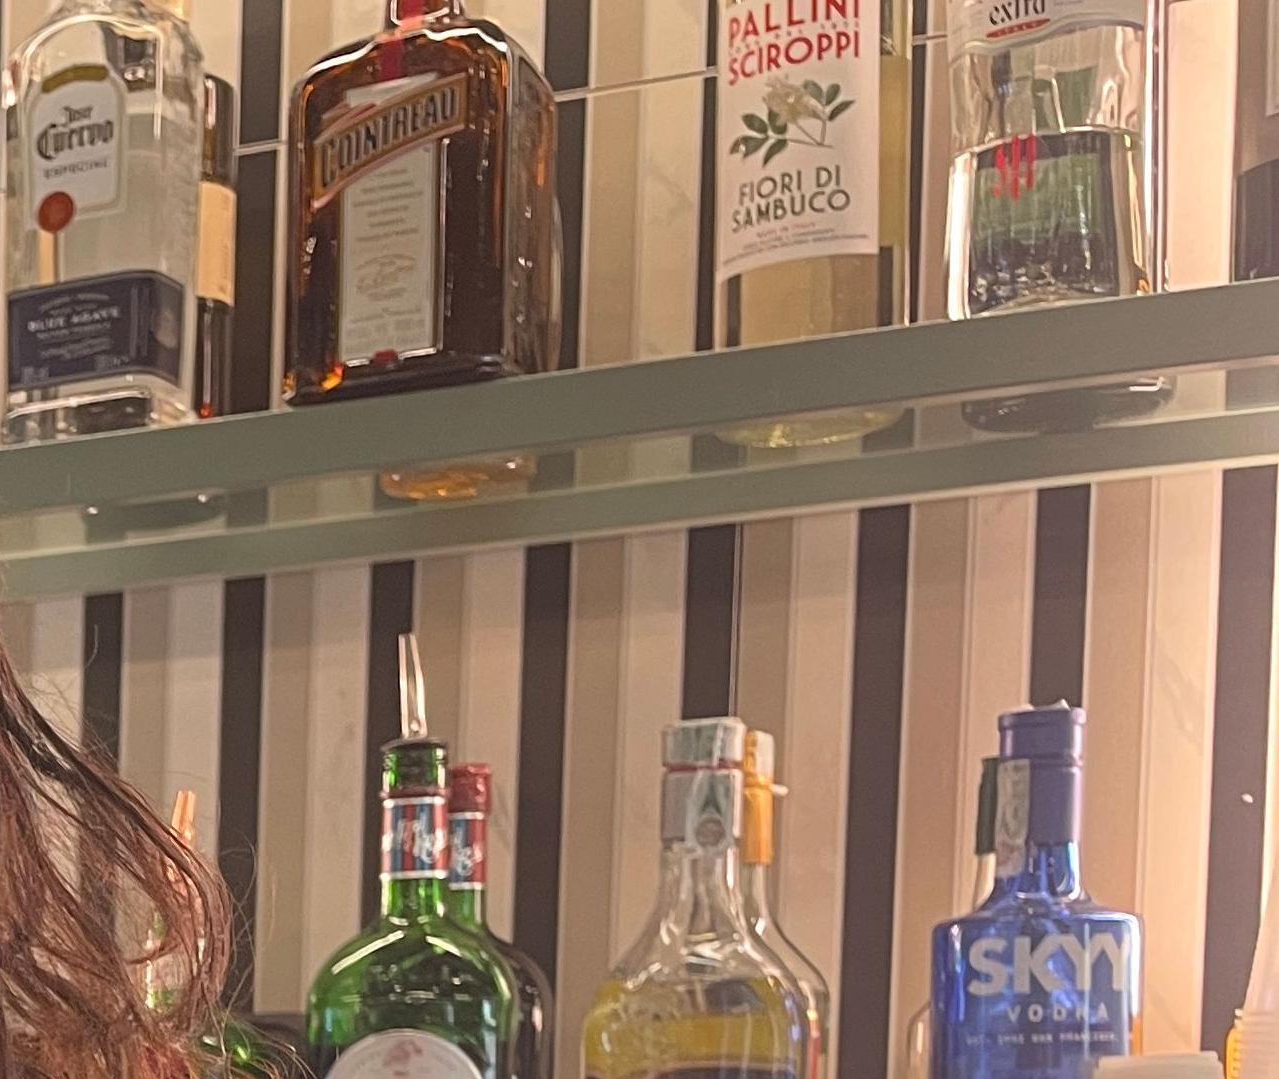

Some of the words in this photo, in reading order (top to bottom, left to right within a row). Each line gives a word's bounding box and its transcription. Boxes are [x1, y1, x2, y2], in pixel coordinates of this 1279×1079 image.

[728, 0, 859, 48] PALLINI
[728, 31, 859, 86] SCIROPPI
[322, 86, 459, 188] COINTREAU
[739, 169, 802, 206] FIORI
[816, 164, 841, 188] DI
[731, 189, 851, 234] SAMBUCO
[968, 932, 1129, 995] SKYY
